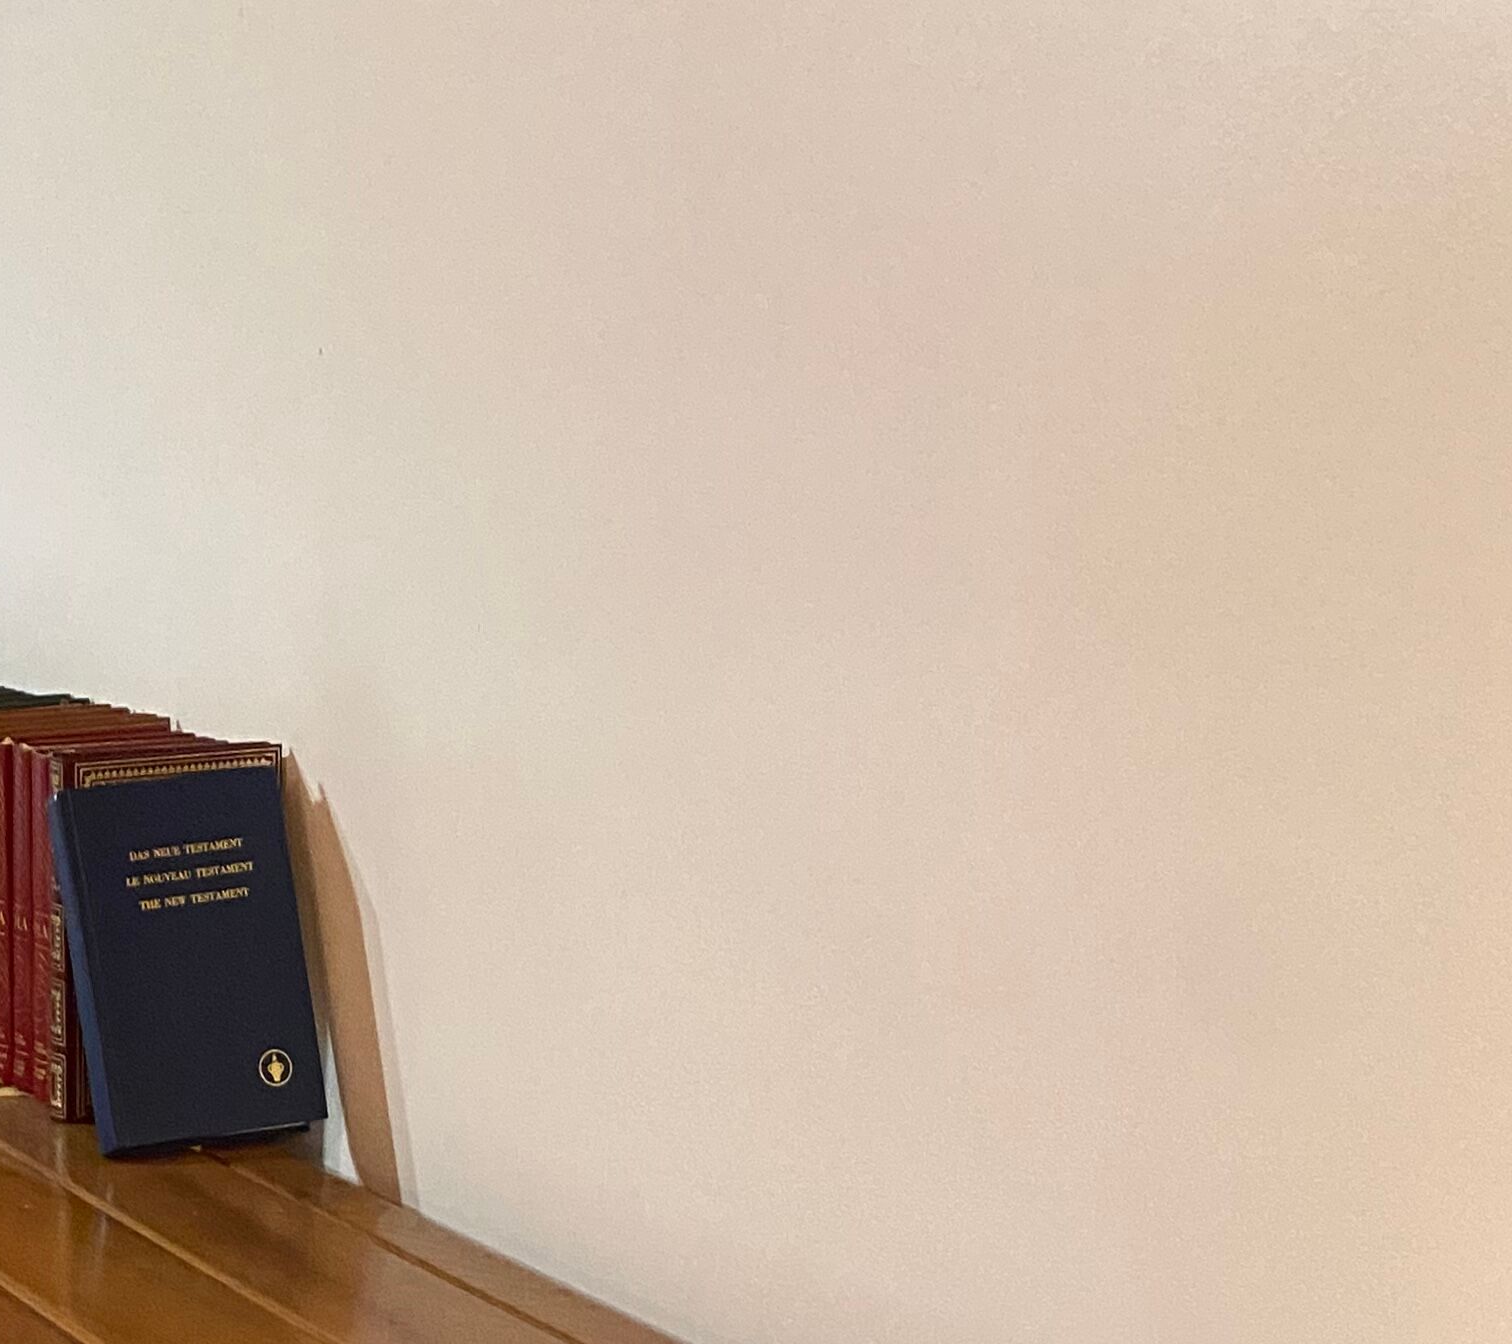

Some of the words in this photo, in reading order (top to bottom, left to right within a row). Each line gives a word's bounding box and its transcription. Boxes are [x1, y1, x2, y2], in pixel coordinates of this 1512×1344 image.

[129, 850, 150, 862] DAS
[153, 846, 181, 858] NEUE
[183, 837, 243, 855] TESTAMENT
[126, 876, 140, 886] LE
[143, 870, 191, 885] NOUVEAU
[196, 861, 253, 878] TESTAMENT
[139, 898, 161, 911] THE
[164, 896, 186, 907] NEW
[191, 887, 249, 904] TESTAMENT
